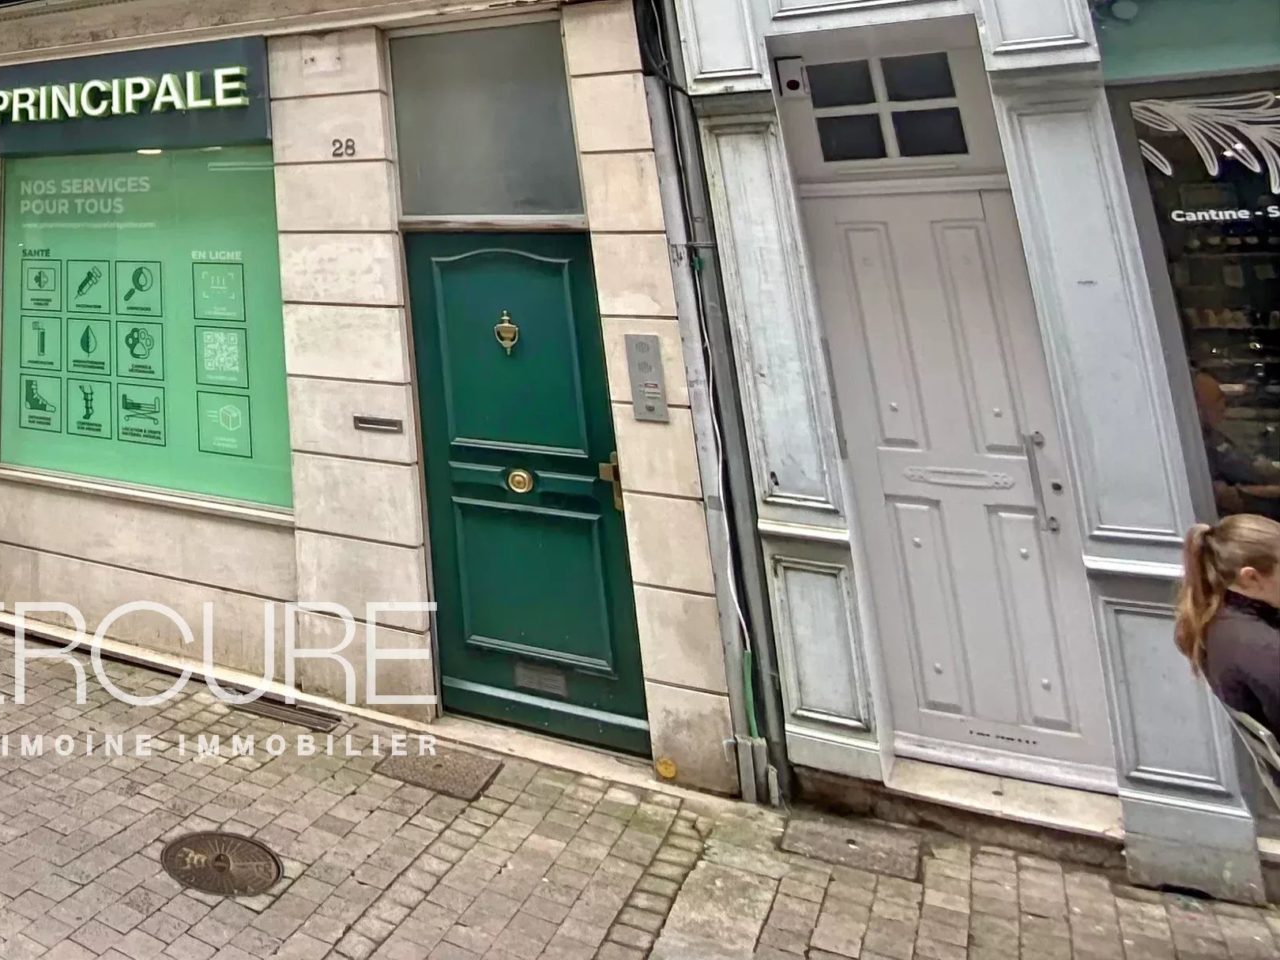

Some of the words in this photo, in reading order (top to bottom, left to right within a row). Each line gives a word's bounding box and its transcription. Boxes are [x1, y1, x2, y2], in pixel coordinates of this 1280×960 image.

[332, 138, 356, 158] 28
[20, 179, 57, 196] NOS
[60, 176, 151, 195] SERVICES
[20, 199, 69, 215] POUR
[73, 198, 125, 215] TOUS
[1171, 209, 1251, 222] Cantine
[191, 250, 206, 260] EN
[209, 250, 243, 261] LIGNE
